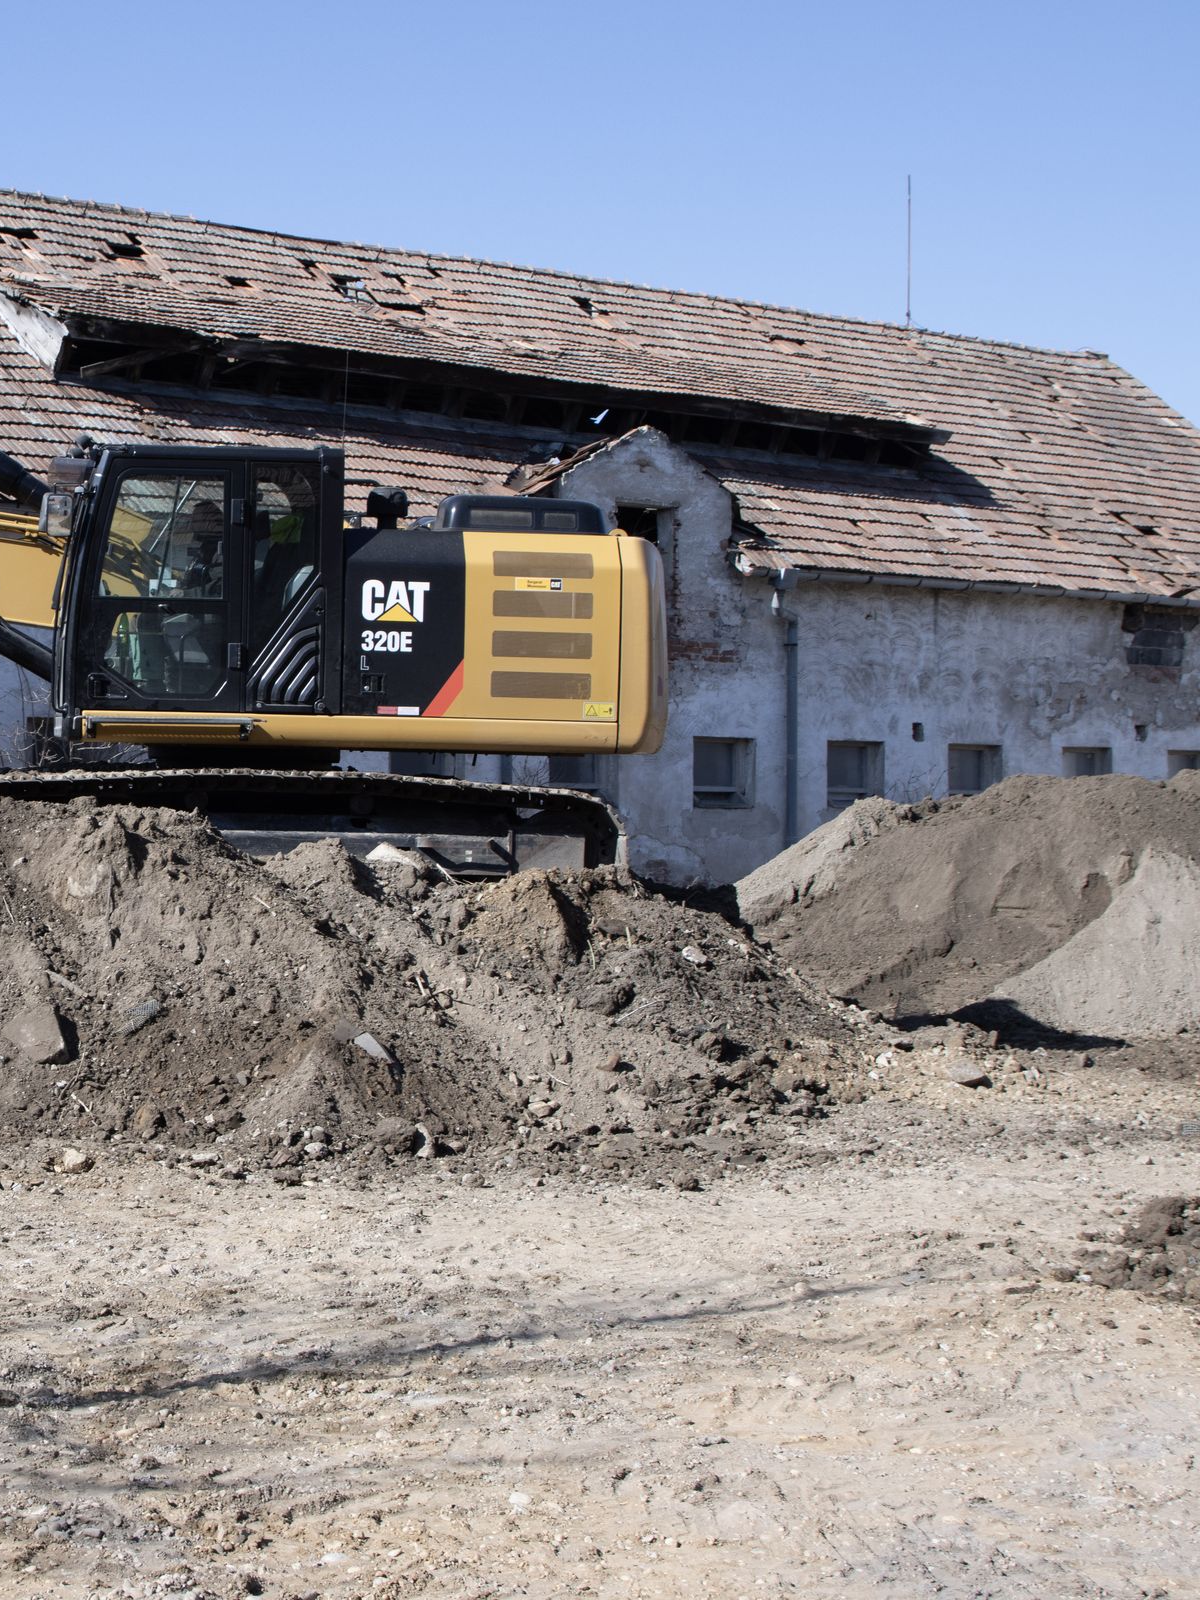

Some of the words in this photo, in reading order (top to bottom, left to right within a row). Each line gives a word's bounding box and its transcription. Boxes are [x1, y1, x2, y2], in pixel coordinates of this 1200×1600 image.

[362, 579, 430, 622] CAT
[361, 630, 413, 652] 320E
[360, 655, 369, 670] L
